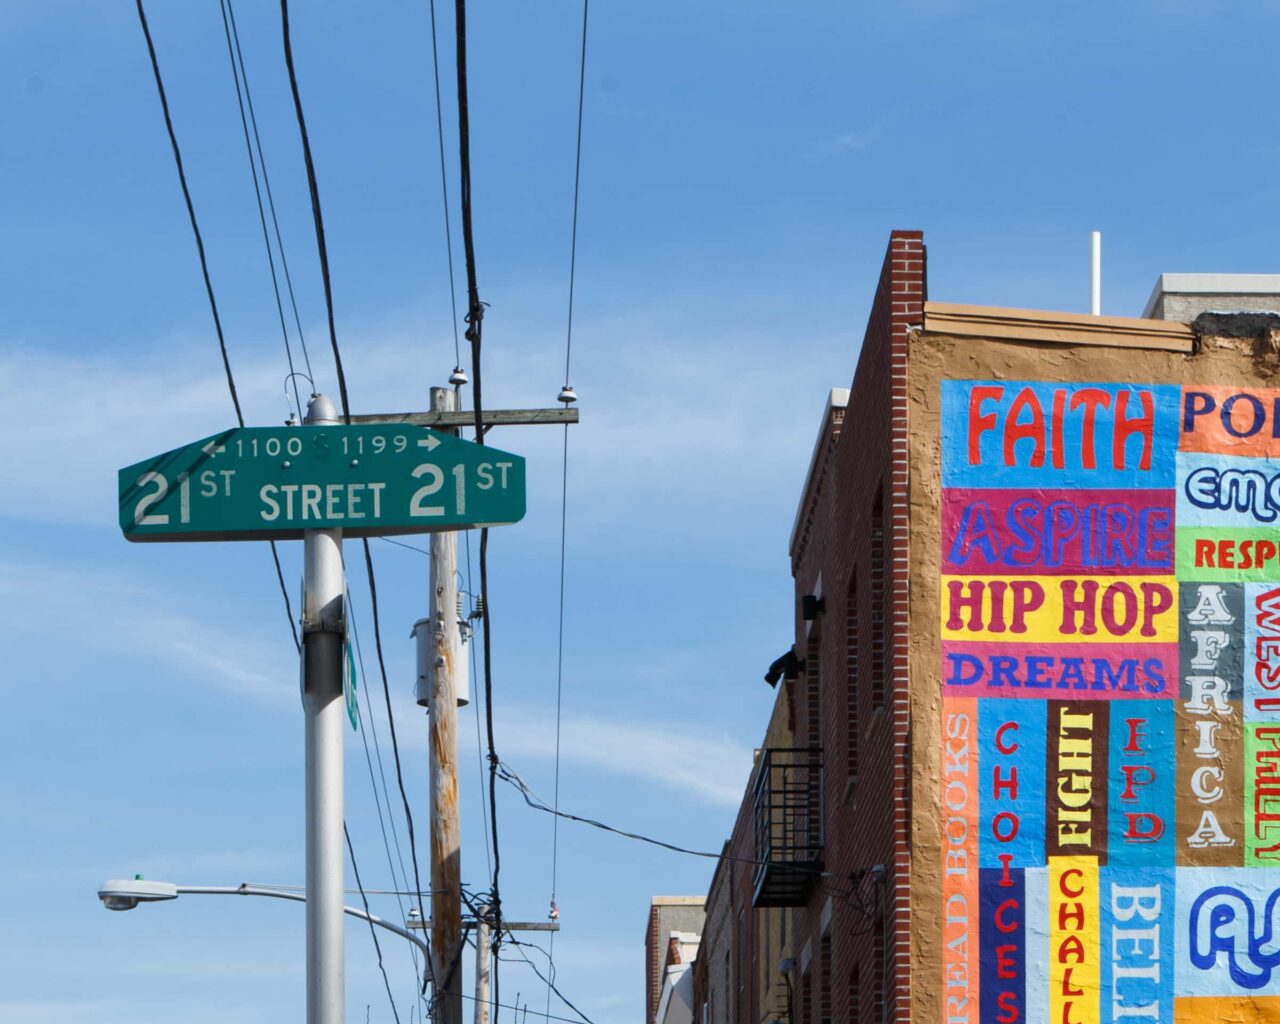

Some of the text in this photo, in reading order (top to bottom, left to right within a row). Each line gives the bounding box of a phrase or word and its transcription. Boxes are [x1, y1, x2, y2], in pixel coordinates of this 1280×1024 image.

[237, 437, 302, 457] 1100
[342, 435, 407, 454] 1199
[968, 386, 1155, 471] FAITH
[260, 483, 386, 521] STREET
[948, 497, 1174, 569] ASPIRE
[945, 579, 1174, 638] HIP HOP
[945, 652, 1167, 694] DREAMS
[1184, 584, 1236, 849] AFRICA
[944, 711, 971, 881] BOOKS
[1057, 705, 1094, 849] FIGHT
[992, 721, 1020, 1024] CHOICES
